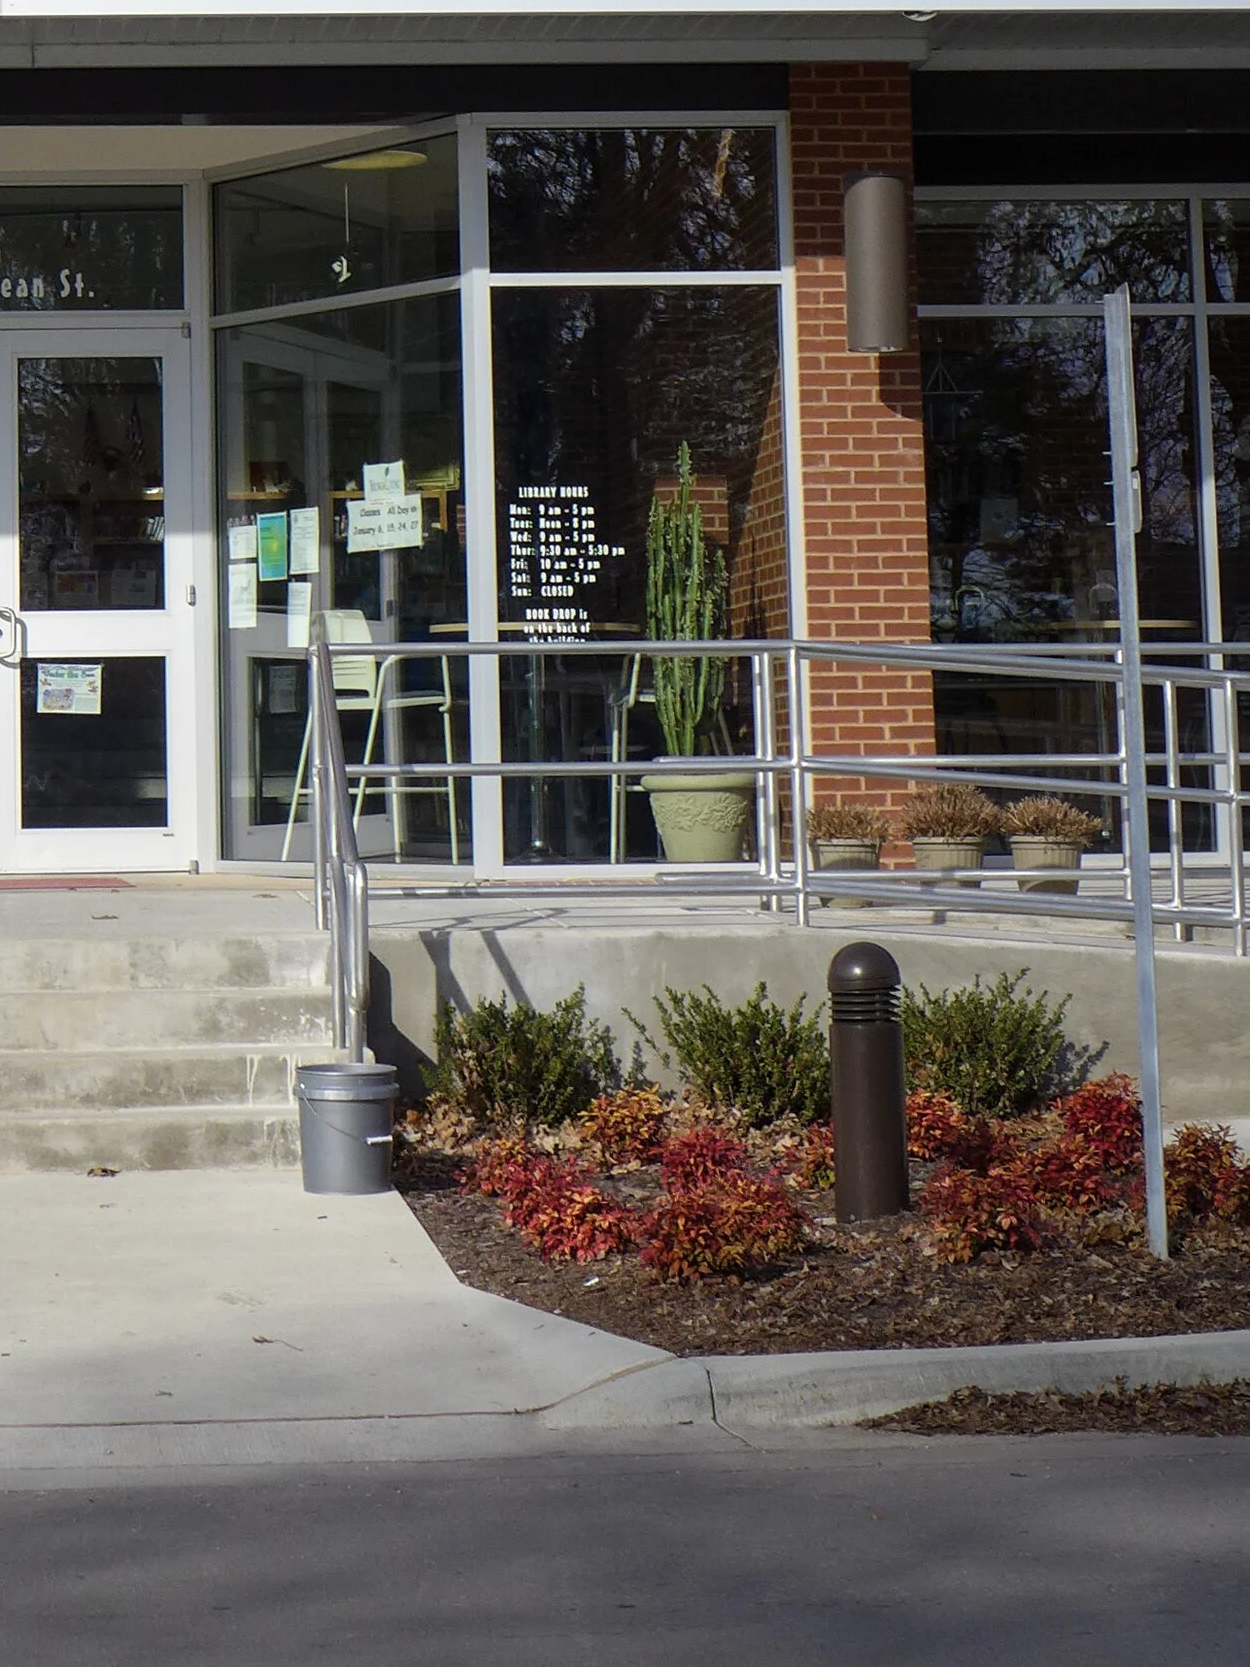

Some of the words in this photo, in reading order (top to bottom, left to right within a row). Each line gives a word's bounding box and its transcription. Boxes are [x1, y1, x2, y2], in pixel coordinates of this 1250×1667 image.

[60, 268, 95, 298] St.
[518, 486, 557, 498] LIBRARY
[559, 486, 589, 498] HOURS
[509, 504, 531, 515] Mon:
[538, 504, 545, 515] 9
[548, 506, 561, 515] am
[581, 506, 595, 516] pm
[538, 517, 561, 528] Noon
[581, 520, 595, 529] pm
[510, 531, 532, 542] Wed:
[539, 531, 546, 542] 9
[549, 533, 562, 542] am
[572, 531, 579, 542] 5
[581, 533, 595, 543] pm
[539, 544, 561, 556] 9:30
[564, 547, 577, 555] am
[588, 544, 609, 555] 5:30
[612, 547, 625, 556] pm
[510, 558, 528, 569] Fri:
[540, 558, 551, 569] 10
[553, 560, 567, 569] am
[578, 558, 584, 569] 5
[587, 560, 601, 570] pm
[511, 572, 531, 583] Sat:
[541, 572, 547, 583] 9
[550, 574, 563, 583] am
[574, 572, 580, 583] 5
[583, 574, 596, 583] pm
[511, 585, 532, 596] Sun:
[541, 585, 574, 596] CLOSED
[525, 608, 549, 620] BOOK
[552, 608, 576, 620] DROP
[579, 608, 588, 619] is
[523, 624, 534, 633] on
[538, 622, 553, 633] the
[556, 622, 577, 633] back
[580, 622, 590, 633] of
